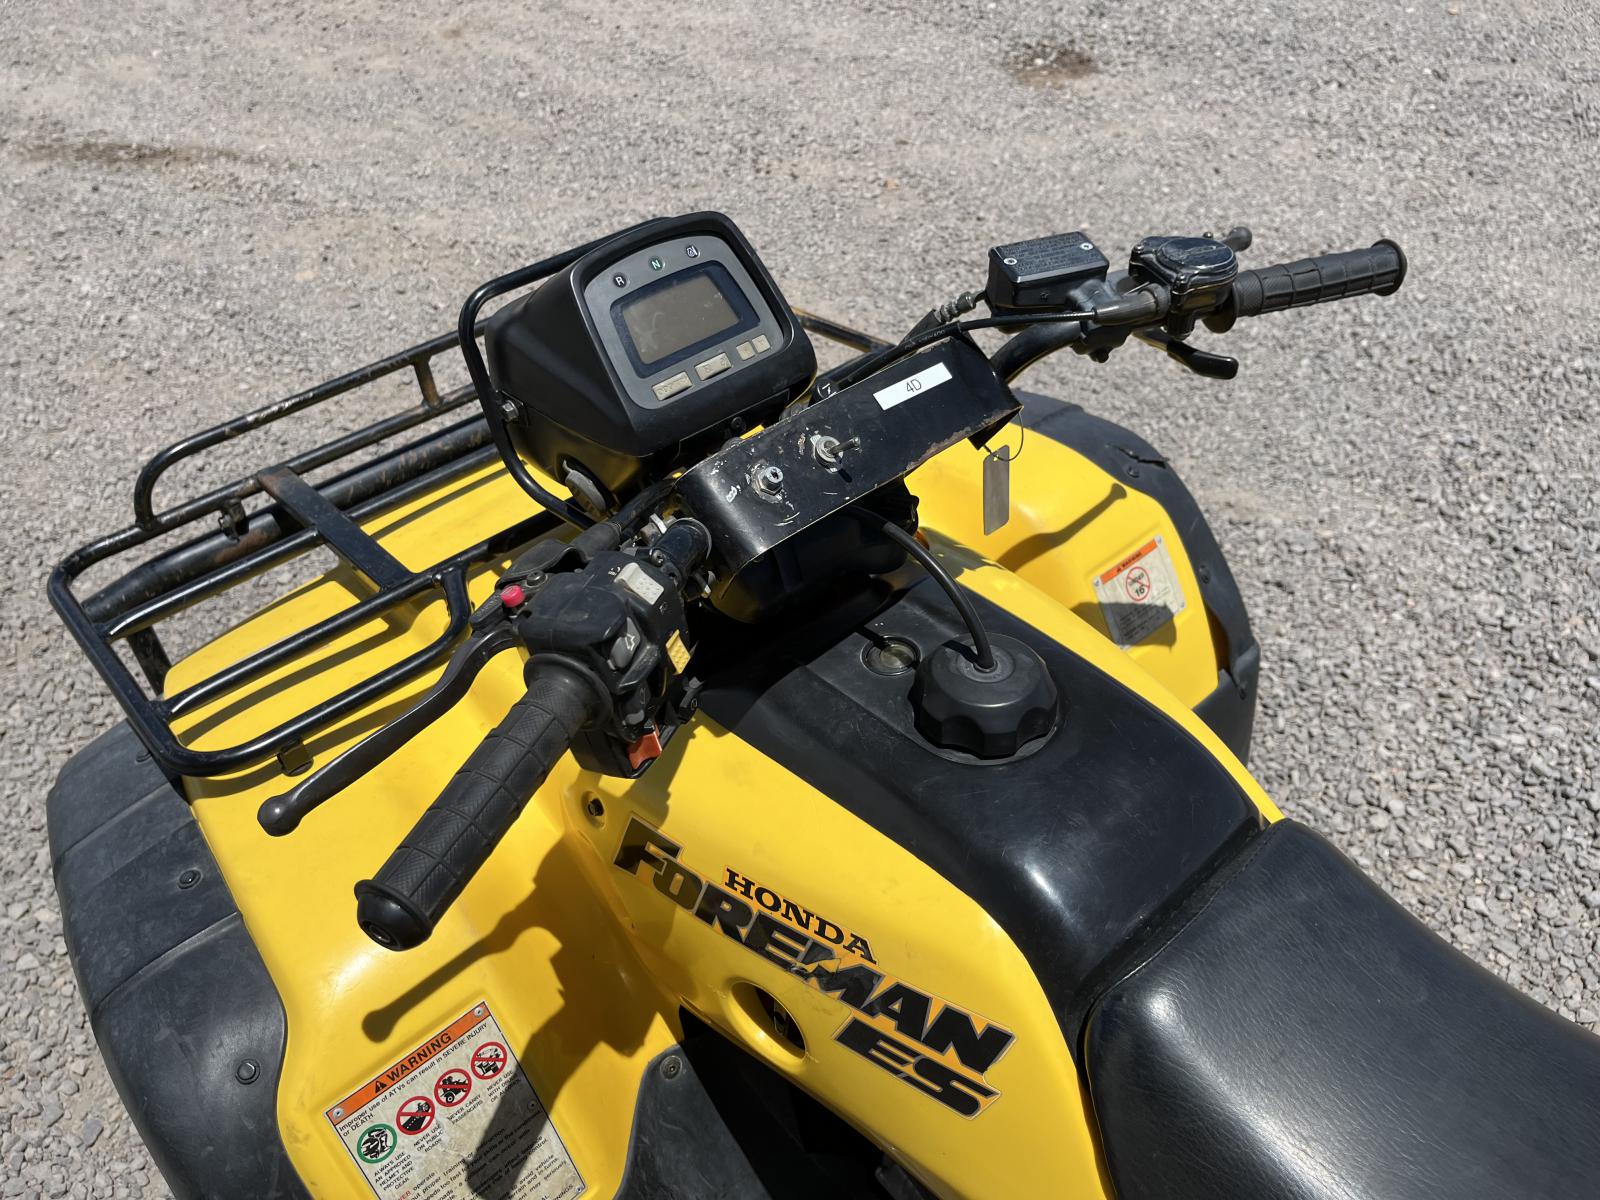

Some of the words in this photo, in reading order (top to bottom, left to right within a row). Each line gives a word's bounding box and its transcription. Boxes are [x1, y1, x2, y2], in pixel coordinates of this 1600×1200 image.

[652, 260, 661, 269] N
[615, 276, 624, 285] R
[906, 379, 922, 392] 4D
[1135, 586, 1145, 597] 16
[725, 868, 877, 964] HONDA
[386, 1031, 451, 1082] WARNING
[836, 1018, 1000, 1118] ES
[339, 1109, 367, 1131] Improper
[368, 1101, 380, 1111] use
[388, 1082, 405, 1097] ATVs
[406, 1074, 417, 1084] can
[418, 1061, 435, 1075] result
[442, 1038, 465, 1057] SEVERE
[466, 1022, 487, 1040] INJURY
[486, 1077, 502, 1091] NEVER
[503, 1069, 513, 1078] USE
[447, 1106, 464, 1121] NEVER
[465, 1093, 481, 1107] CARRY
[412, 1132, 430, 1147] NEVER
[431, 1124, 440, 1133] USE
[416, 1143, 425, 1151] ON
[426, 1129, 443, 1144] PUBLIC
[373, 1159, 394, 1176] ALWAYS
[395, 1151, 404, 1160] USE
[374, 1175, 382, 1183] AN
[384, 1153, 411, 1175] APPROVED
[379, 1169, 399, 1187] HELMET
[401, 1160, 412, 1170] AND
[382, 1166, 414, 1191] PROTECTIVE
[394, 1176, 409, 1189] GEAR
